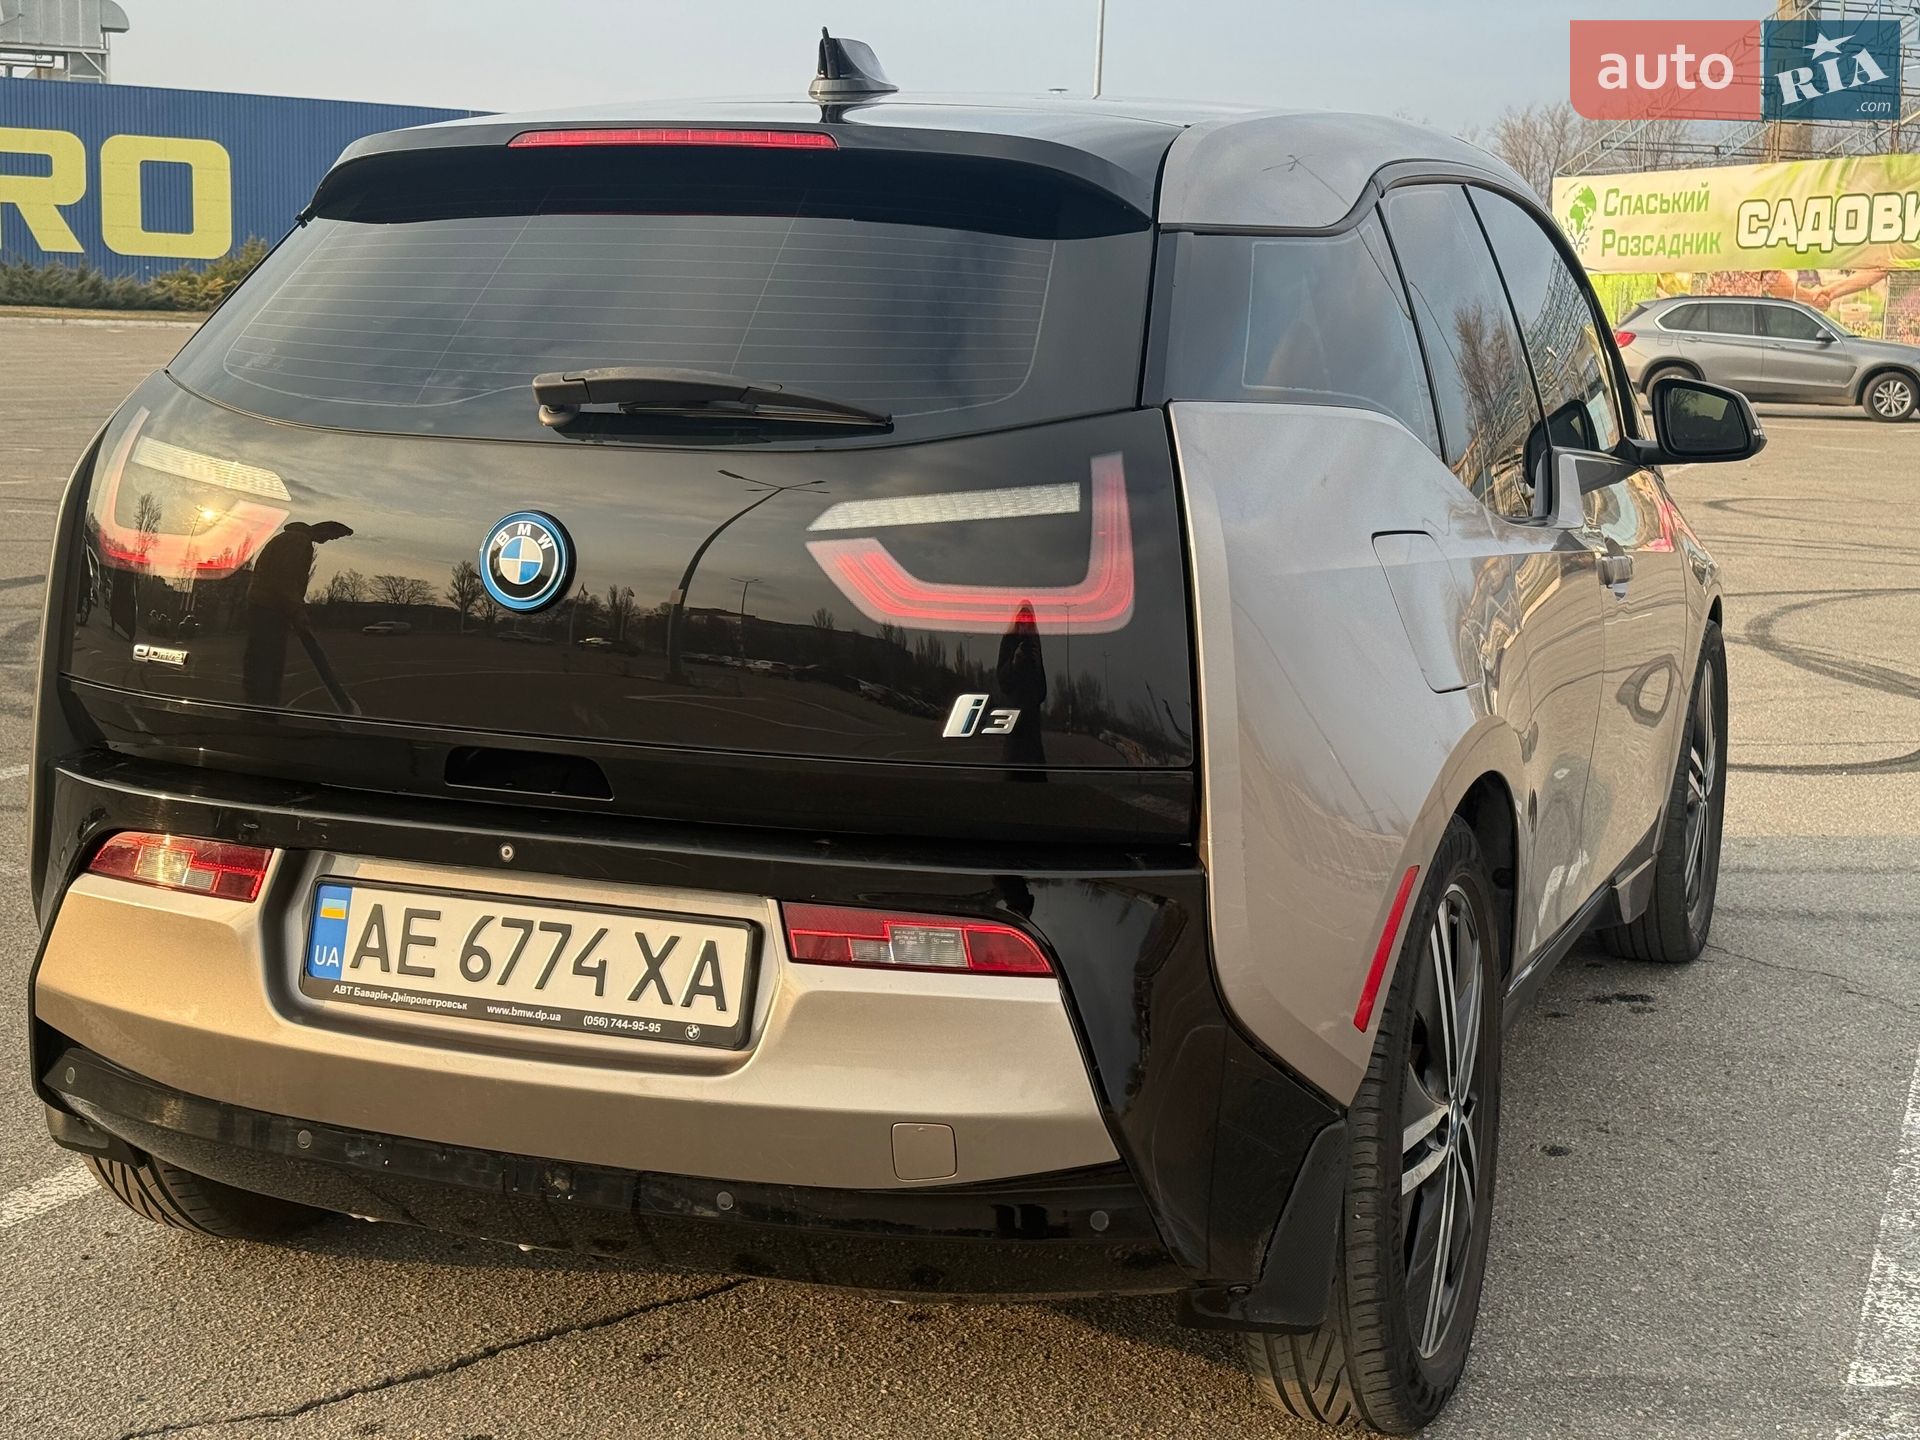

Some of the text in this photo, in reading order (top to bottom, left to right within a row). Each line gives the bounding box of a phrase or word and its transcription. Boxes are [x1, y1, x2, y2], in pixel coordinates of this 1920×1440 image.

[495, 523, 553, 550] BMW
[942, 693, 1021, 738] i3
[314, 945, 340, 967] UA
[349, 903, 727, 1011] AE 6774 XA
[332, 984, 468, 1010] АВТ Баварія-Дніпропетровськ
[487, 1005, 562, 1022] www.bmw.dp.ua
[583, 1014, 662, 1033] (056) 744-95-95
